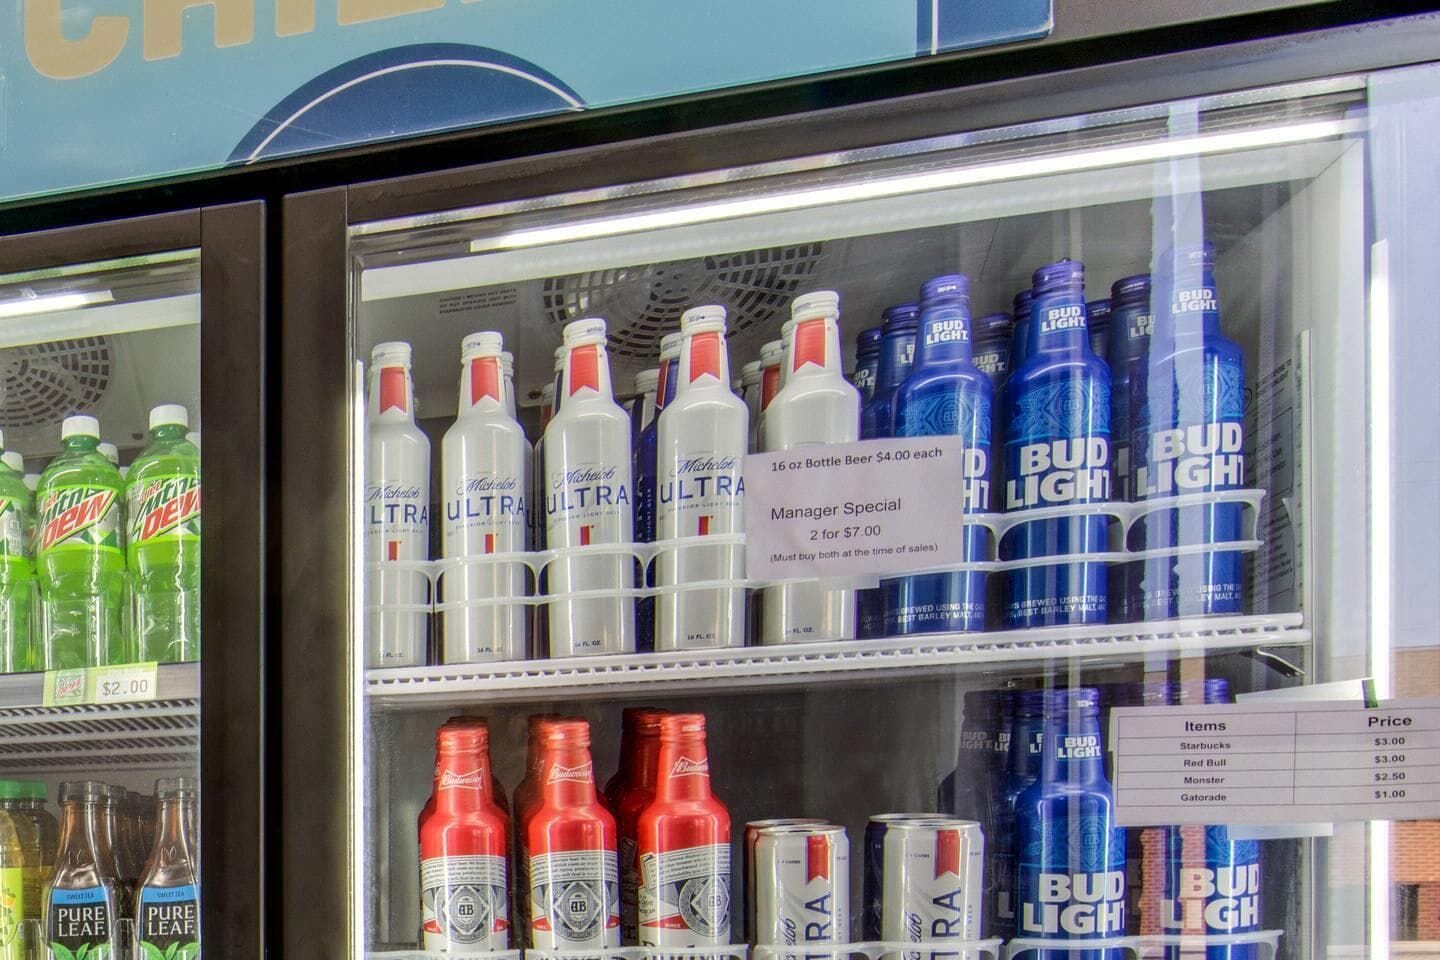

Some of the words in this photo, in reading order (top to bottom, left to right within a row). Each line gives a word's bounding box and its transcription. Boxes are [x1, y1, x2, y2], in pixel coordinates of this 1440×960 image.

[1179, 289, 1213, 302] BUD
[1047, 306, 1081, 319] BUD
[1172, 299, 1217, 314] LIGHT
[933, 319, 964, 333] BUD
[1041, 316, 1085, 331] LIGHT
[926, 330, 968, 344] LIGHT
[1152, 422, 1242, 461] BUD
[771, 461, 786, 472] 16
[789, 461, 802, 471] oz
[805, 455, 841, 469] Bottle
[845, 453, 873, 466] Beer
[876, 449, 910, 464] $4.00
[913, 447, 942, 460] each
[1020, 437, 1108, 476] BUD
[670, 456, 736, 477] Michelob
[553, 465, 616, 489] Michelob
[1137, 455, 1244, 498] LIGHT
[368, 486, 421, 501] Michelob
[456, 477, 517, 496] Michelob
[660, 475, 745, 504] ULTRA
[1006, 471, 1109, 510] LIGHT
[447, 495, 526, 521] ULTRA
[546, 484, 630, 515] ULTRA
[371, 503, 428, 525] LTRA
[771, 503, 838, 521] Manager
[843, 497, 901, 516] Special
[810, 529, 818, 541] 2
[822, 527, 840, 540] for
[844, 524, 881, 539] $7.00
[770, 552, 796, 563] (Must
[799, 551, 815, 562] buy
[818, 550, 840, 560] both
[842, 549, 852, 558] at
[854, 547, 869, 557] the
[872, 546, 893, 556] time
[896, 544, 906, 554] of
[909, 543, 939, 554] sales)
[918, 611, 951, 622] BARLEY
[1017, 608, 1038, 618] BEST
[1041, 606, 1076, 616] BARLEY
[101, 679, 148, 696] $2.00
[1184, 719, 1227, 732] Items
[1367, 715, 1412, 728] Price
[1064, 736, 1097, 748] BUD
[1180, 741, 1231, 751] Starbucks
[1374, 736, 1405, 747] $3.00
[1058, 747, 1100, 758] LIGHT
[1183, 758, 1203, 768] Red
[1206, 758, 1226, 768] Bull
[1374, 754, 1405, 764] $3.00
[442, 771, 481, 788] Budweiser
[1183, 775, 1225, 785] Monster
[1374, 771, 1406, 782] $2.50
[1180, 792, 1227, 802] Gatorade
[1374, 789, 1406, 799] $1.00
[1038, 871, 1125, 903] BUD
[1180, 864, 1259, 898] BUD
[58, 906, 105, 922] PURE
[148, 904, 194, 921] PURE
[58, 921, 106, 937] LEAF
[148, 920, 195, 936] LEAF
